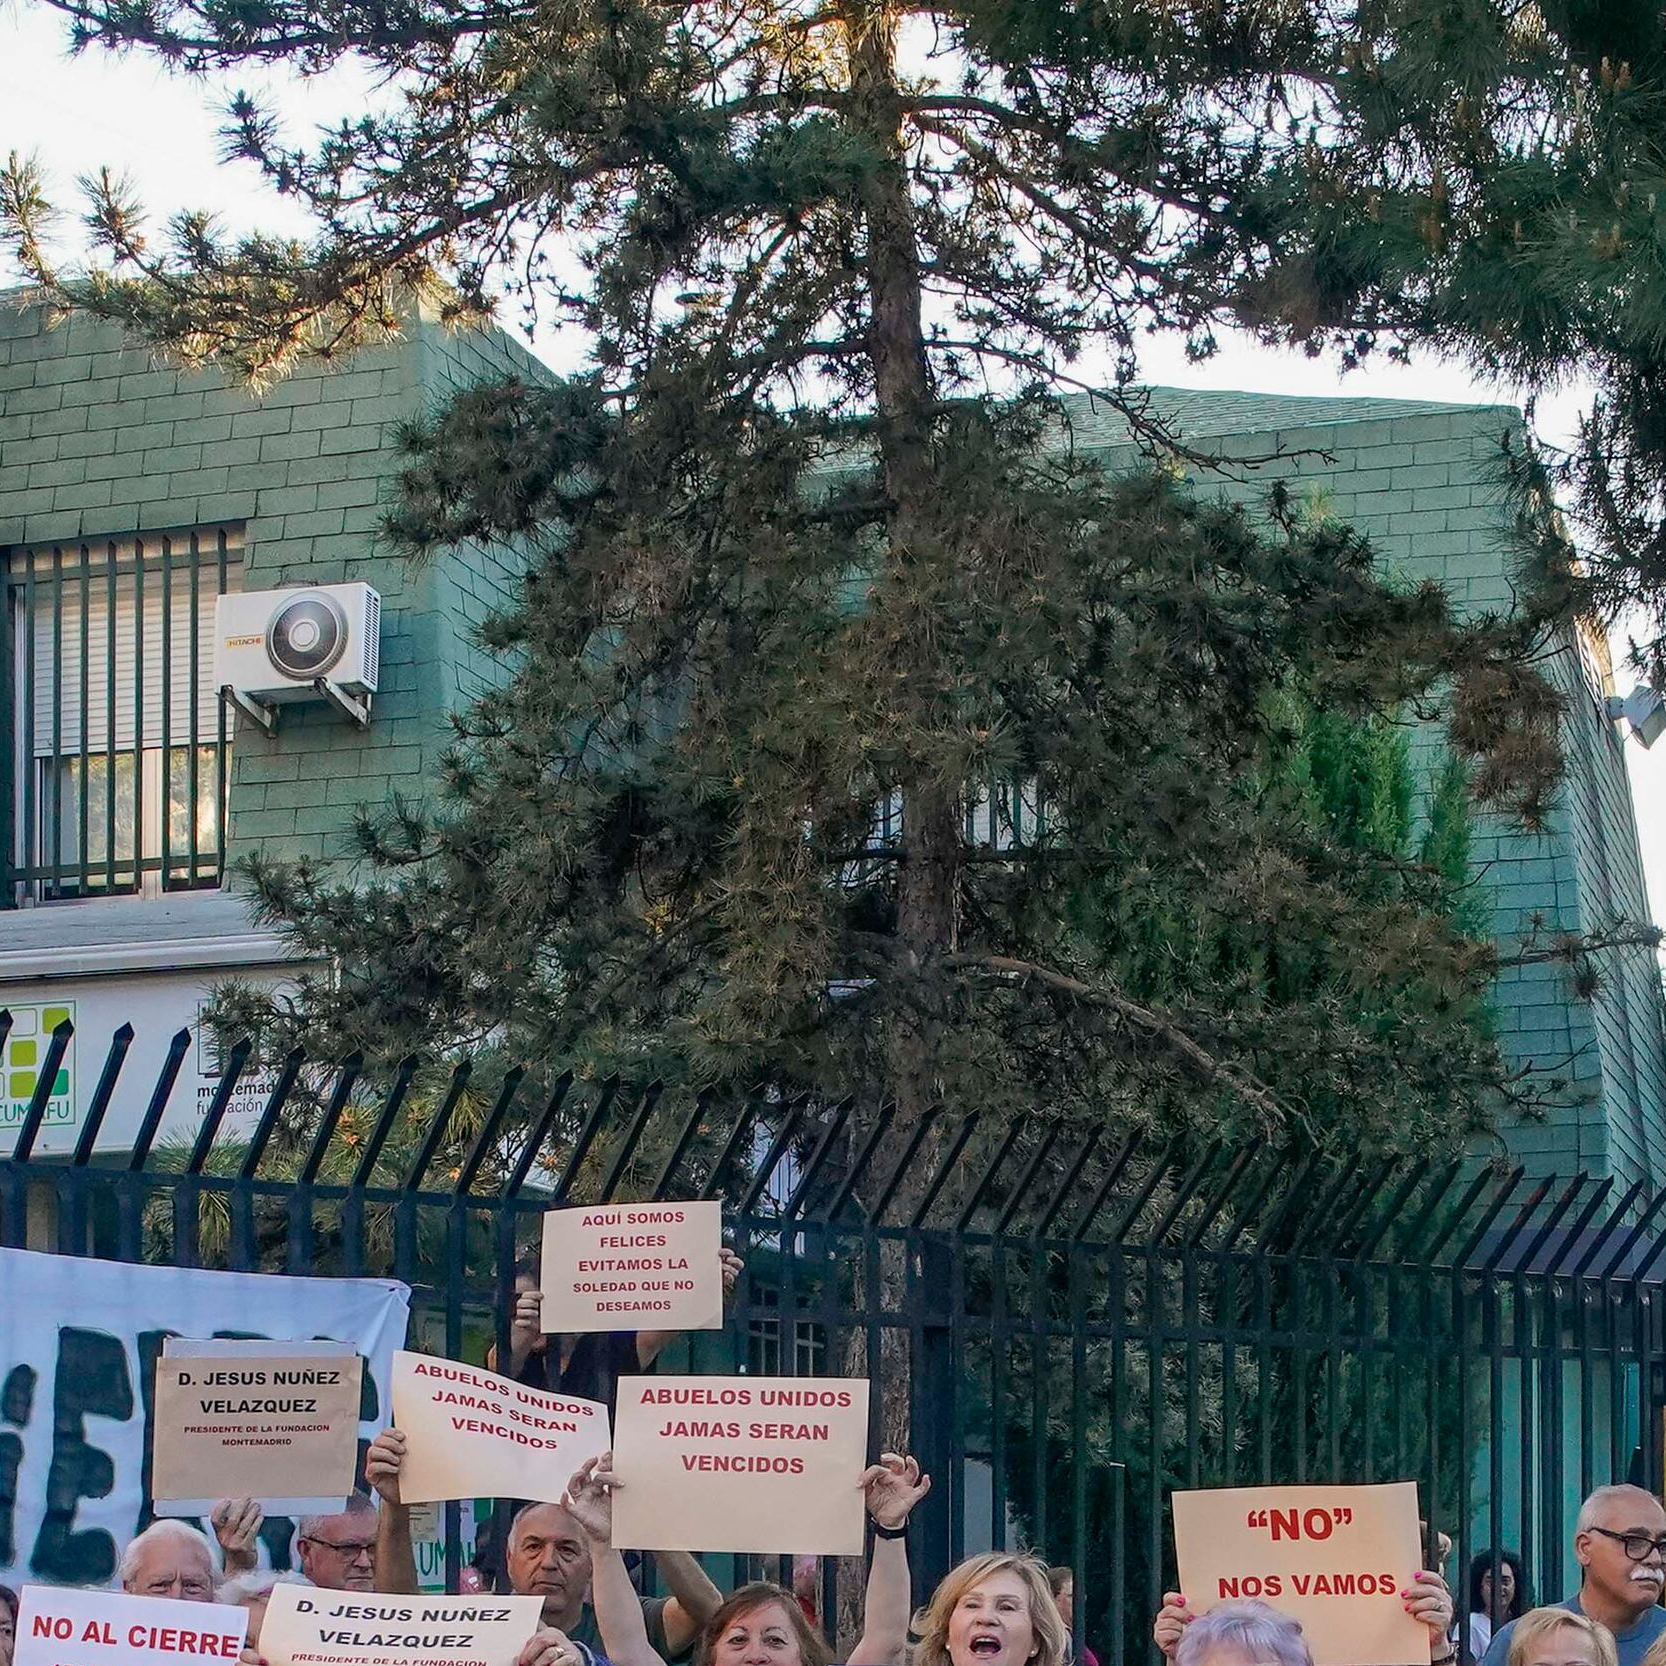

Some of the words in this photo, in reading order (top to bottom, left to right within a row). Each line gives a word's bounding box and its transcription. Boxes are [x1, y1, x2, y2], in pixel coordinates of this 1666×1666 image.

[582, 1212, 620, 1226] AQUÍ
[627, 1212, 684, 1224] SOMOS
[601, 1235, 666, 1248] FELICES
[579, 1259, 662, 1271] EVITAMOS
[669, 1258, 688, 1269] LA
[574, 1282, 636, 1292] SOLEDAD
[641, 1281, 669, 1291] QUE
[674, 1279, 694, 1291] NO
[597, 1301, 671, 1311] DESEAMOS
[641, 1389, 751, 1405] ABUELOS
[761, 1391, 851, 1407] UNIDOS
[660, 1422, 740, 1438] JAMAS
[749, 1424, 828, 1440] SERAN
[682, 1455, 803, 1473] VENCIDOS
[1219, 1576, 1282, 1598] NOS
[1291, 1574, 1396, 1595] VAMOS
[297, 1600, 319, 1614] D.
[329, 1606, 412, 1621] JESUS
[422, 1608, 511, 1622] NUÑEZ
[33, 1616, 72, 1639] NO
[81, 1621, 117, 1644] AL
[129, 1626, 239, 1658] CIERRE
[320, 1630, 473, 1648] VELAZQUEZ
